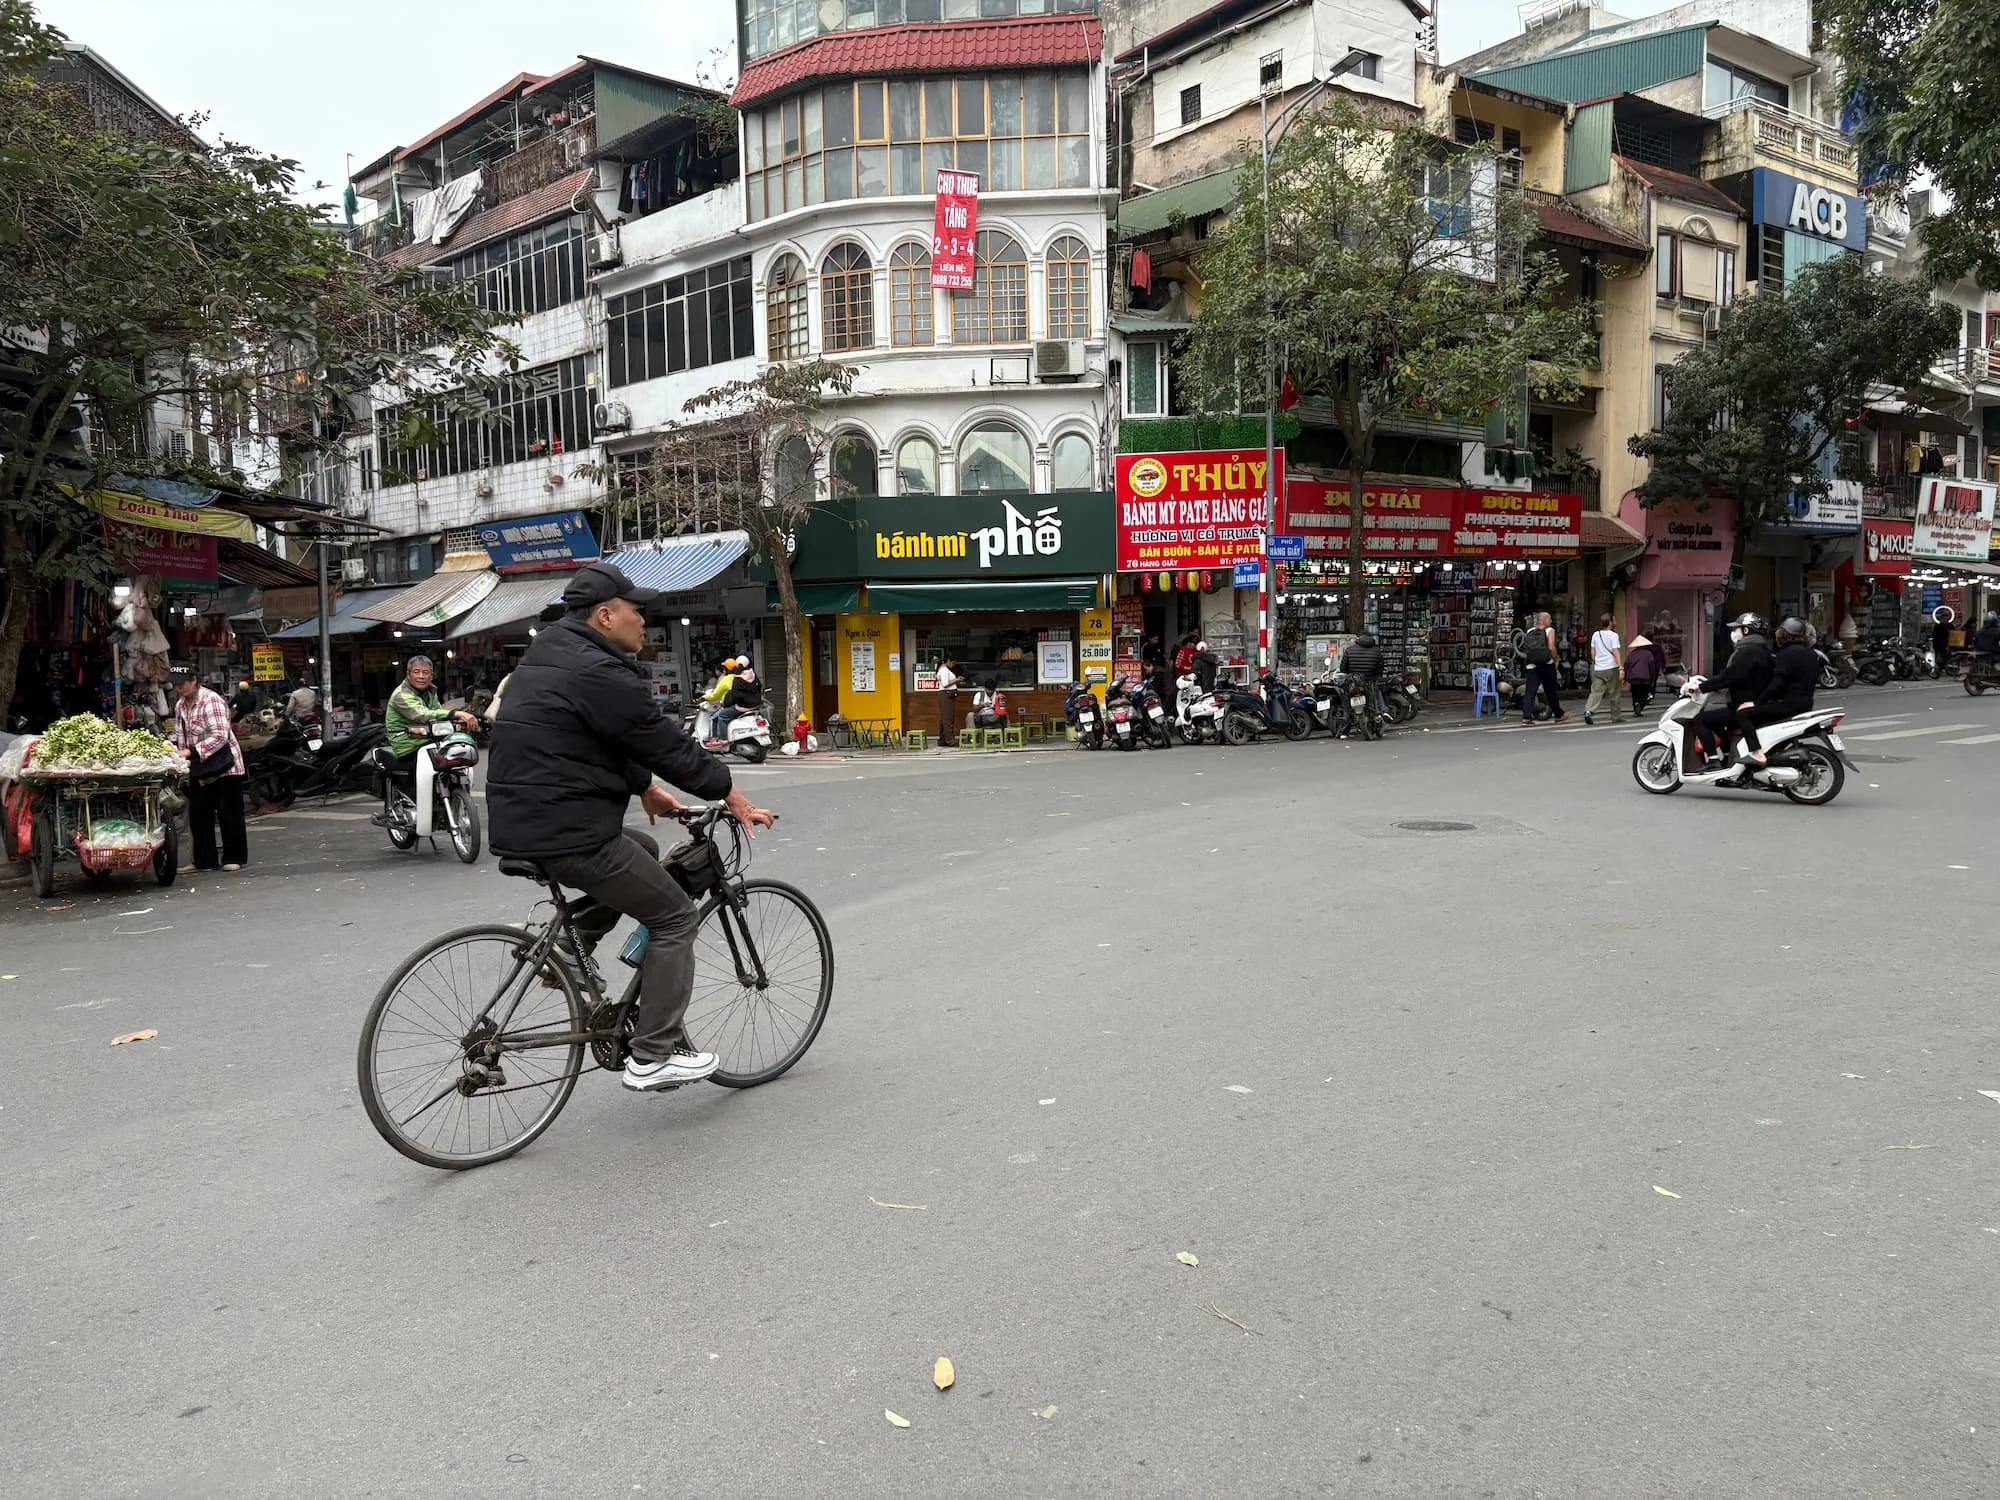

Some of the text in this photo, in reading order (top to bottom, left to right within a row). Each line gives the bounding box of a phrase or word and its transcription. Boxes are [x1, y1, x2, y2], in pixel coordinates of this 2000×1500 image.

[937, 174, 954, 194] CHO
[1788, 183, 1847, 239] ACB
[934, 237, 941, 254] 2
[951, 238, 957, 256] 3
[967, 239, 974, 256] 4
[1122, 496, 1157, 526] BÁNH
[1179, 498, 1210, 524] PATE
[1211, 492, 1246, 523] HÀNG
[876, 531, 934, 559] bánh
[970, 498, 1062, 568] phố
[1139, 546, 1160, 558] BÁN
[1126, 560, 1138, 568] 76
[1088, 619, 1102, 629] 78
